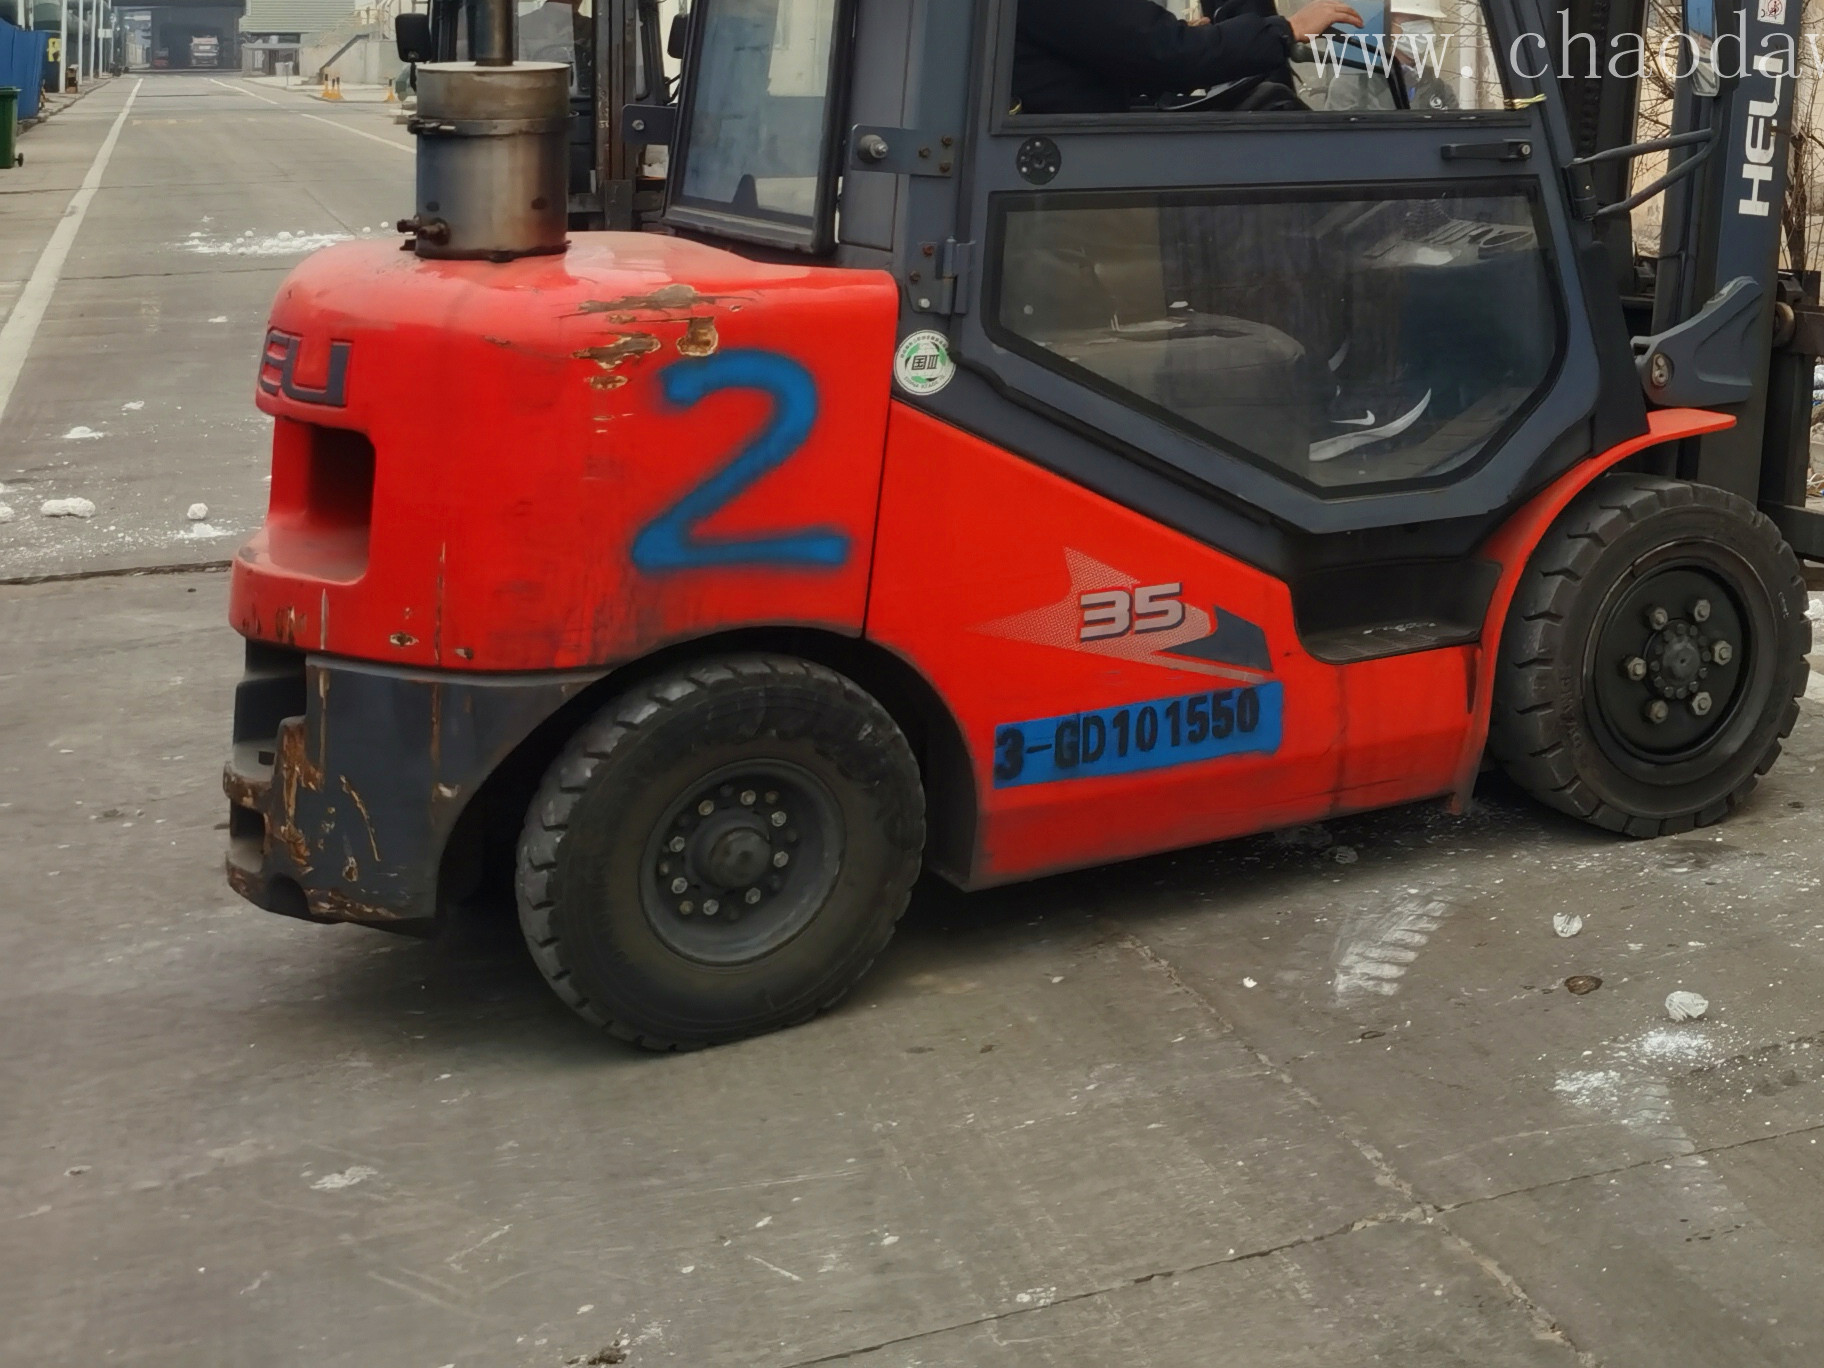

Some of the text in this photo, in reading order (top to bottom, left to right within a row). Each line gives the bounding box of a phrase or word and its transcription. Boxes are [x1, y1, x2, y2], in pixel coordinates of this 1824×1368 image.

[1738, 55, 1783, 217] HELI
[632, 348, 849, 571] 2
[1080, 582, 1185, 642] 35
